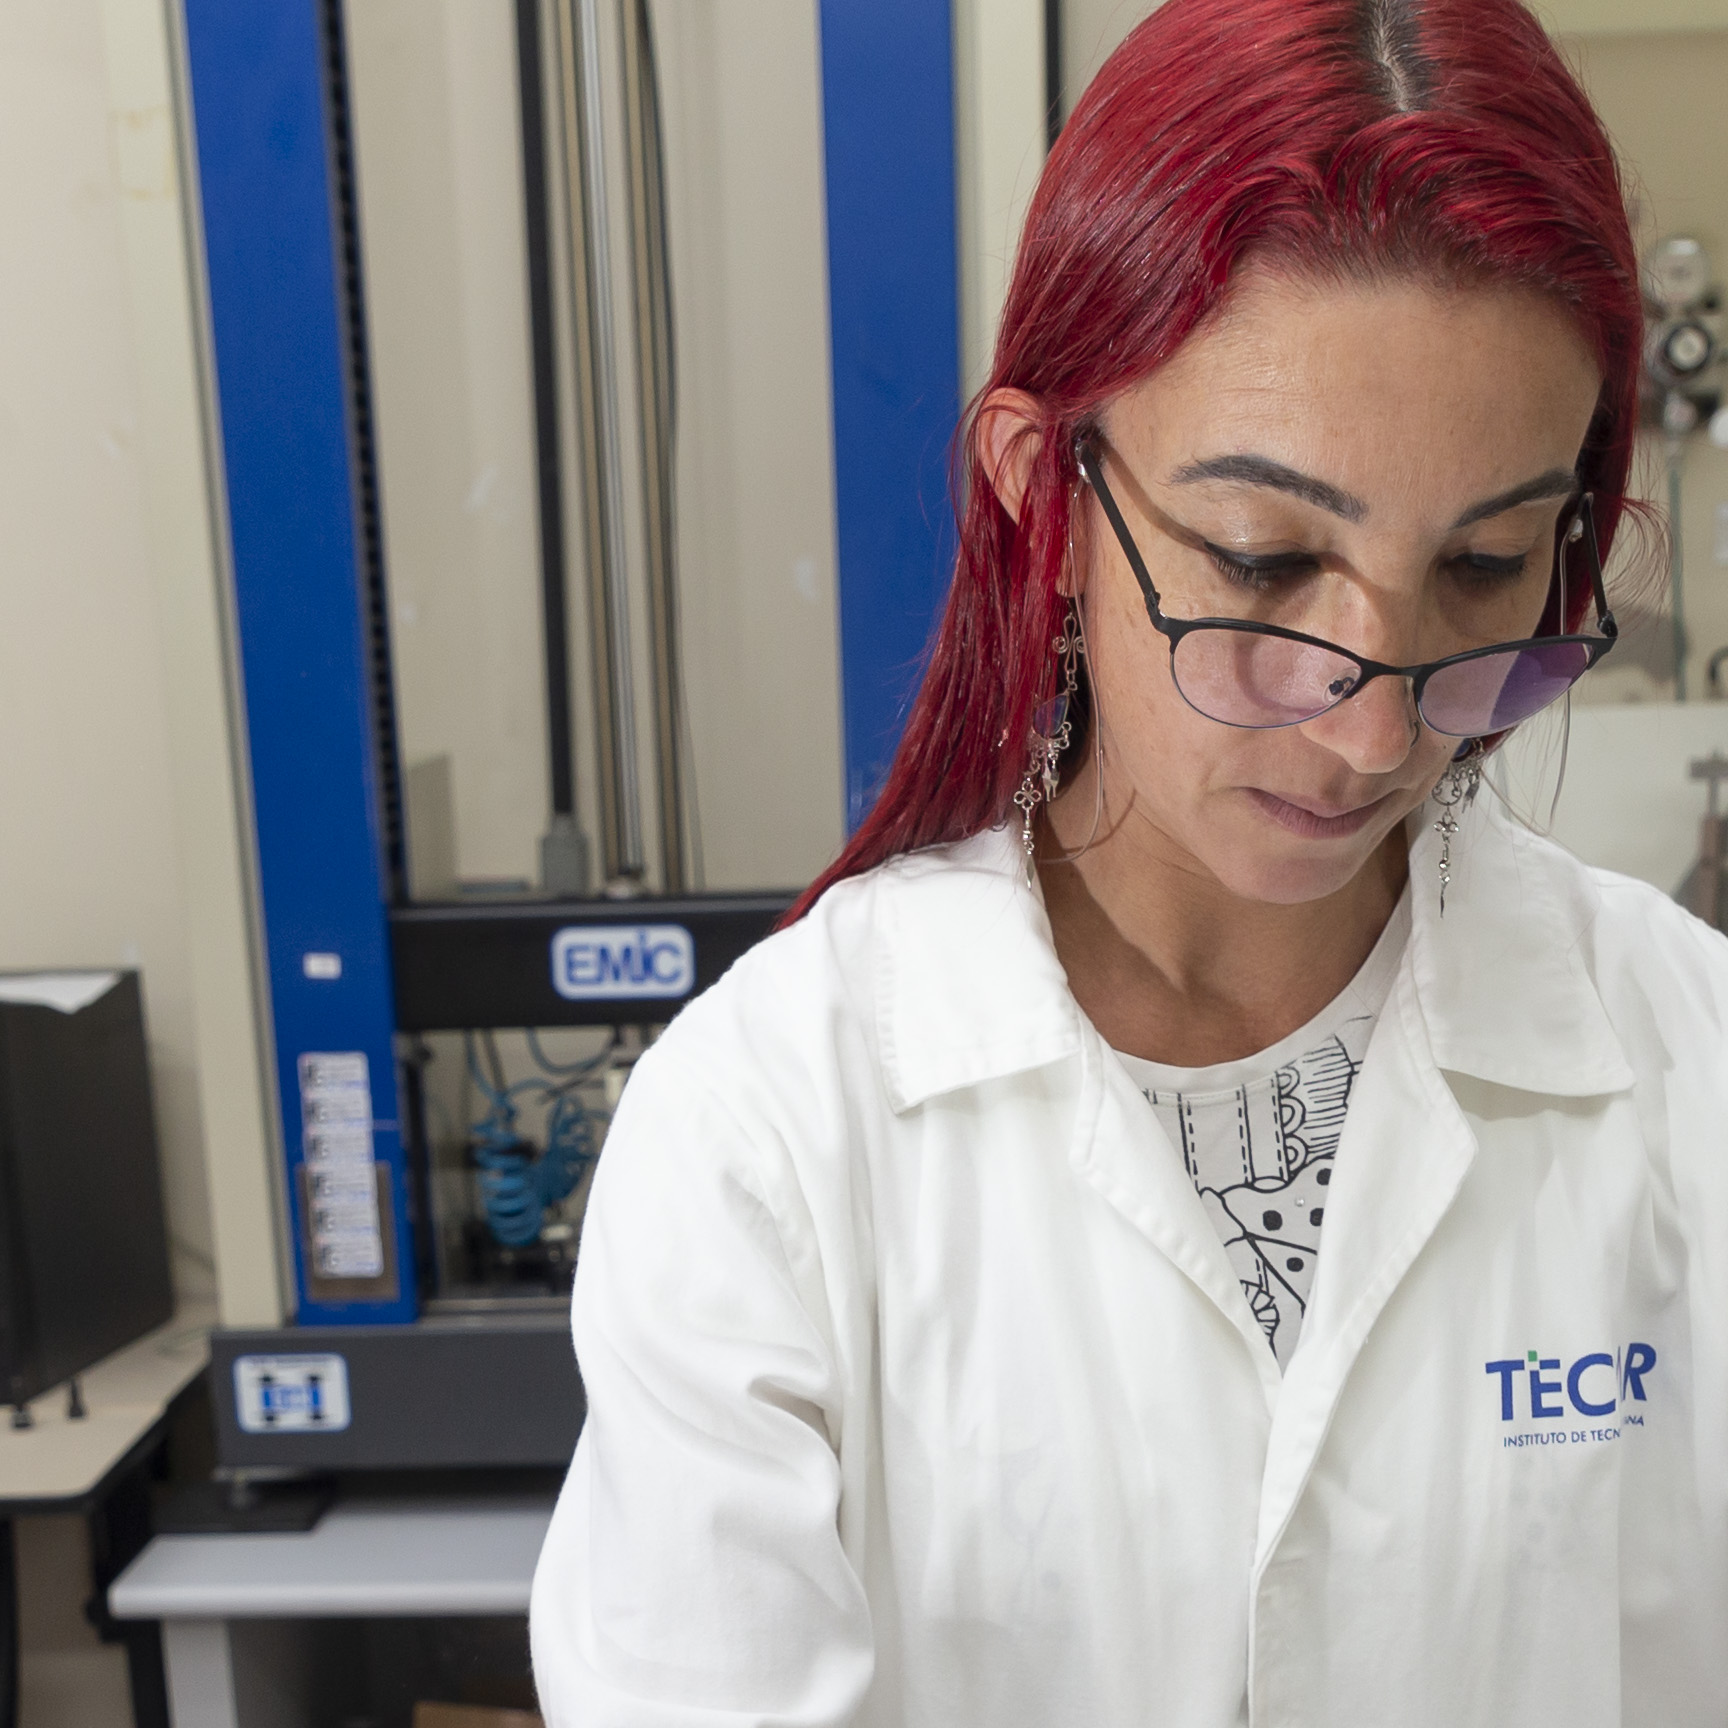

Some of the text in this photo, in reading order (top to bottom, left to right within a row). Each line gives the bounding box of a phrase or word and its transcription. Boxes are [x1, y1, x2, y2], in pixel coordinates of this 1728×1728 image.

[1503, 1431, 1567, 1448] INSTITUTO
[1571, 1430, 1588, 1444] DE
[1590, 1427, 1622, 1442] TECN
